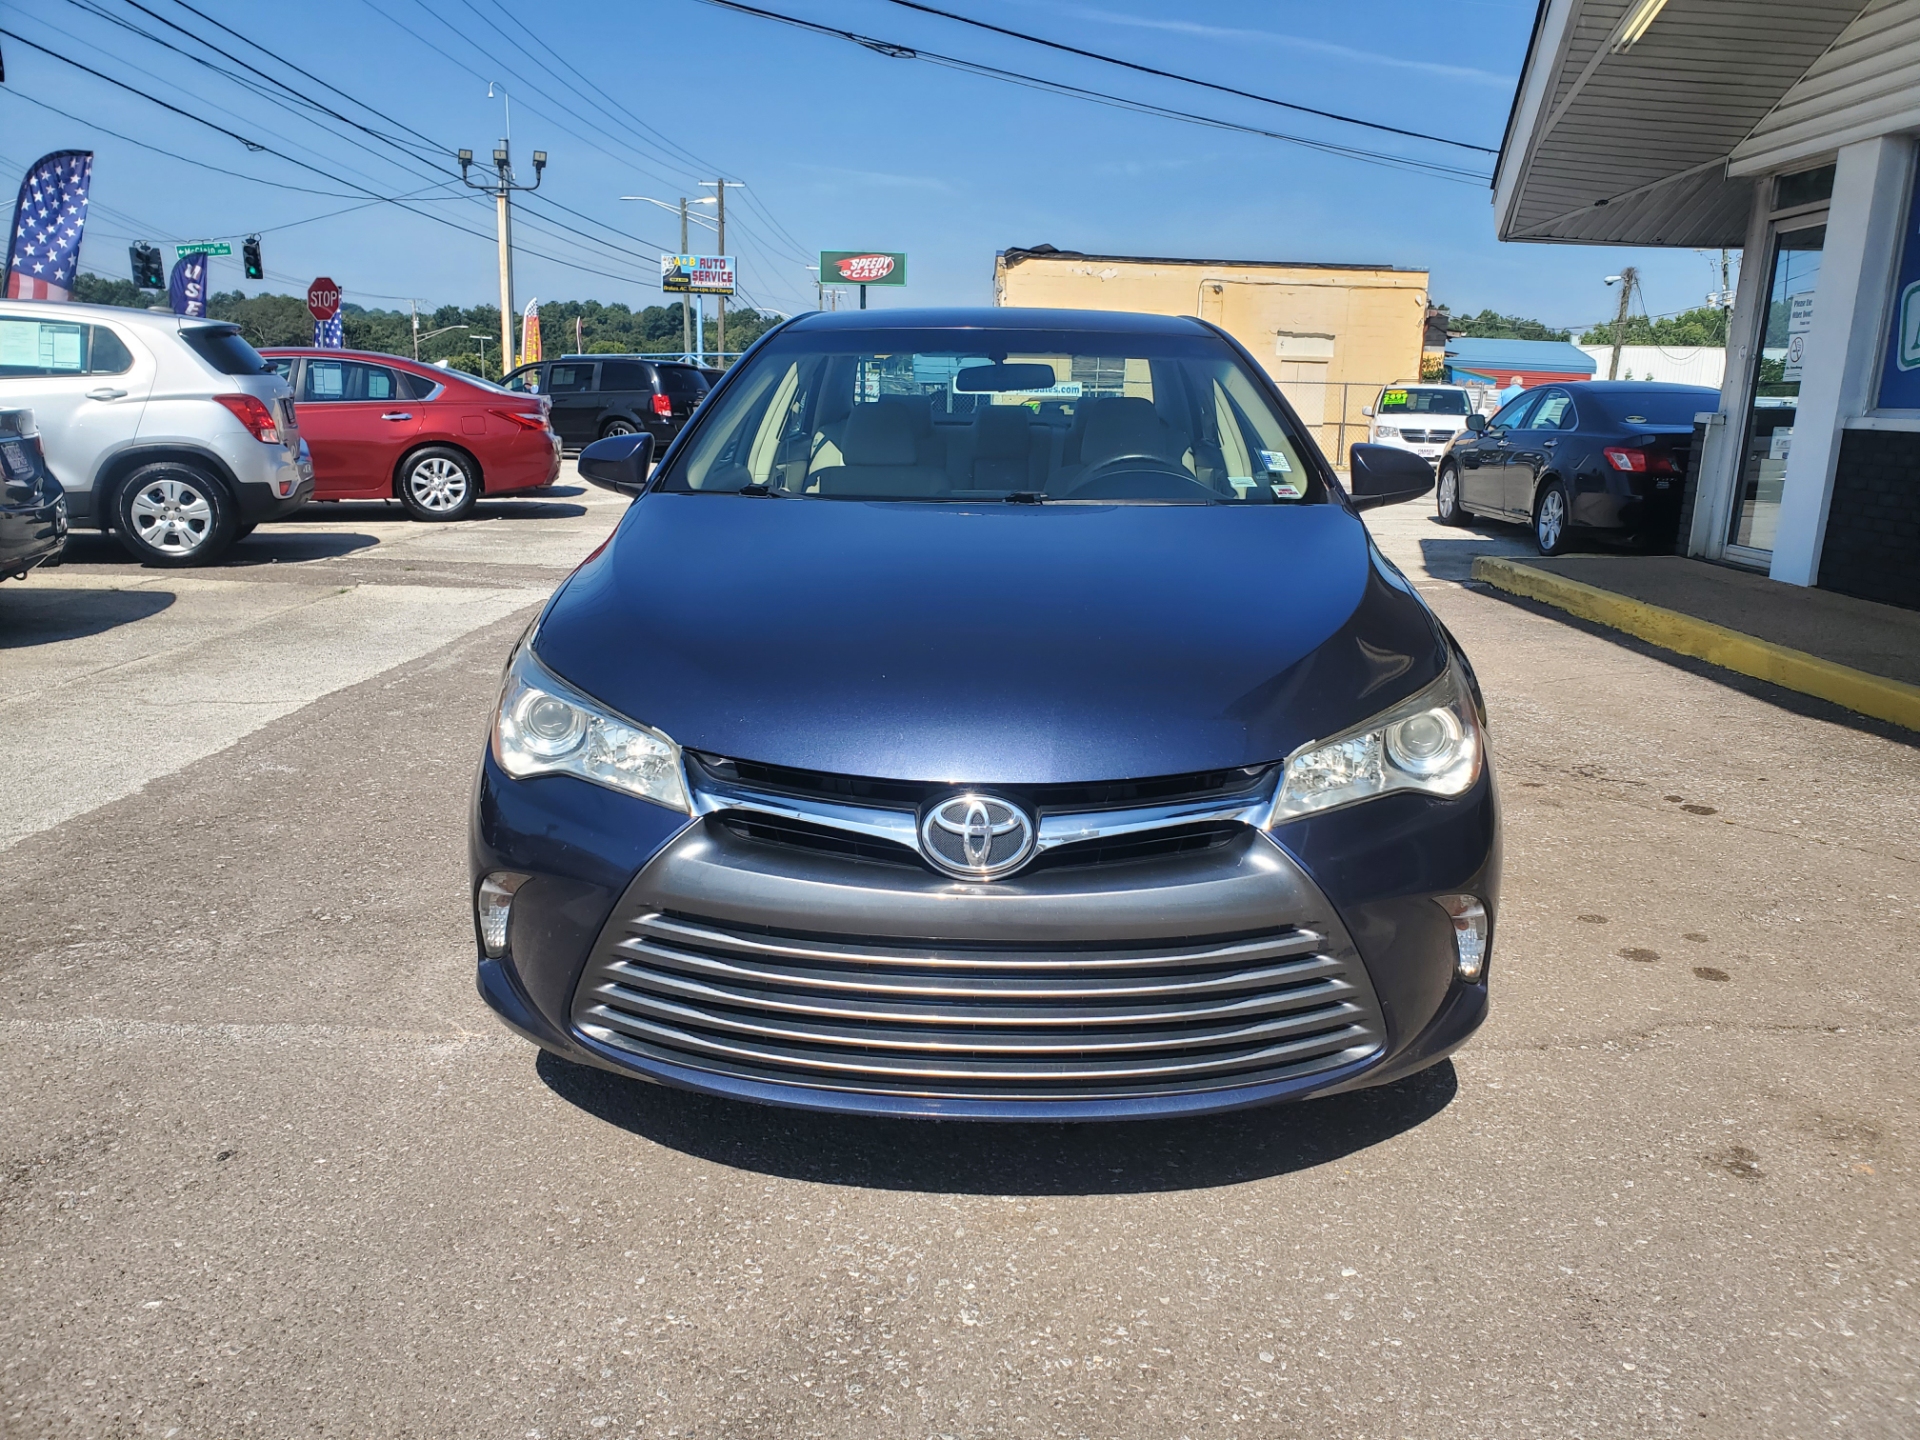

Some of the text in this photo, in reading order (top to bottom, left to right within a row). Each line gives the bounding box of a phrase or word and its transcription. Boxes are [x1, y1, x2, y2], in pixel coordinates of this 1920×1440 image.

[688, 257, 696, 267] B
[699, 258, 726, 269] AUTO
[849, 256, 895, 271] SPEEDY
[692, 270, 733, 282] SERVICE
[310, 290, 338, 307] STOP
